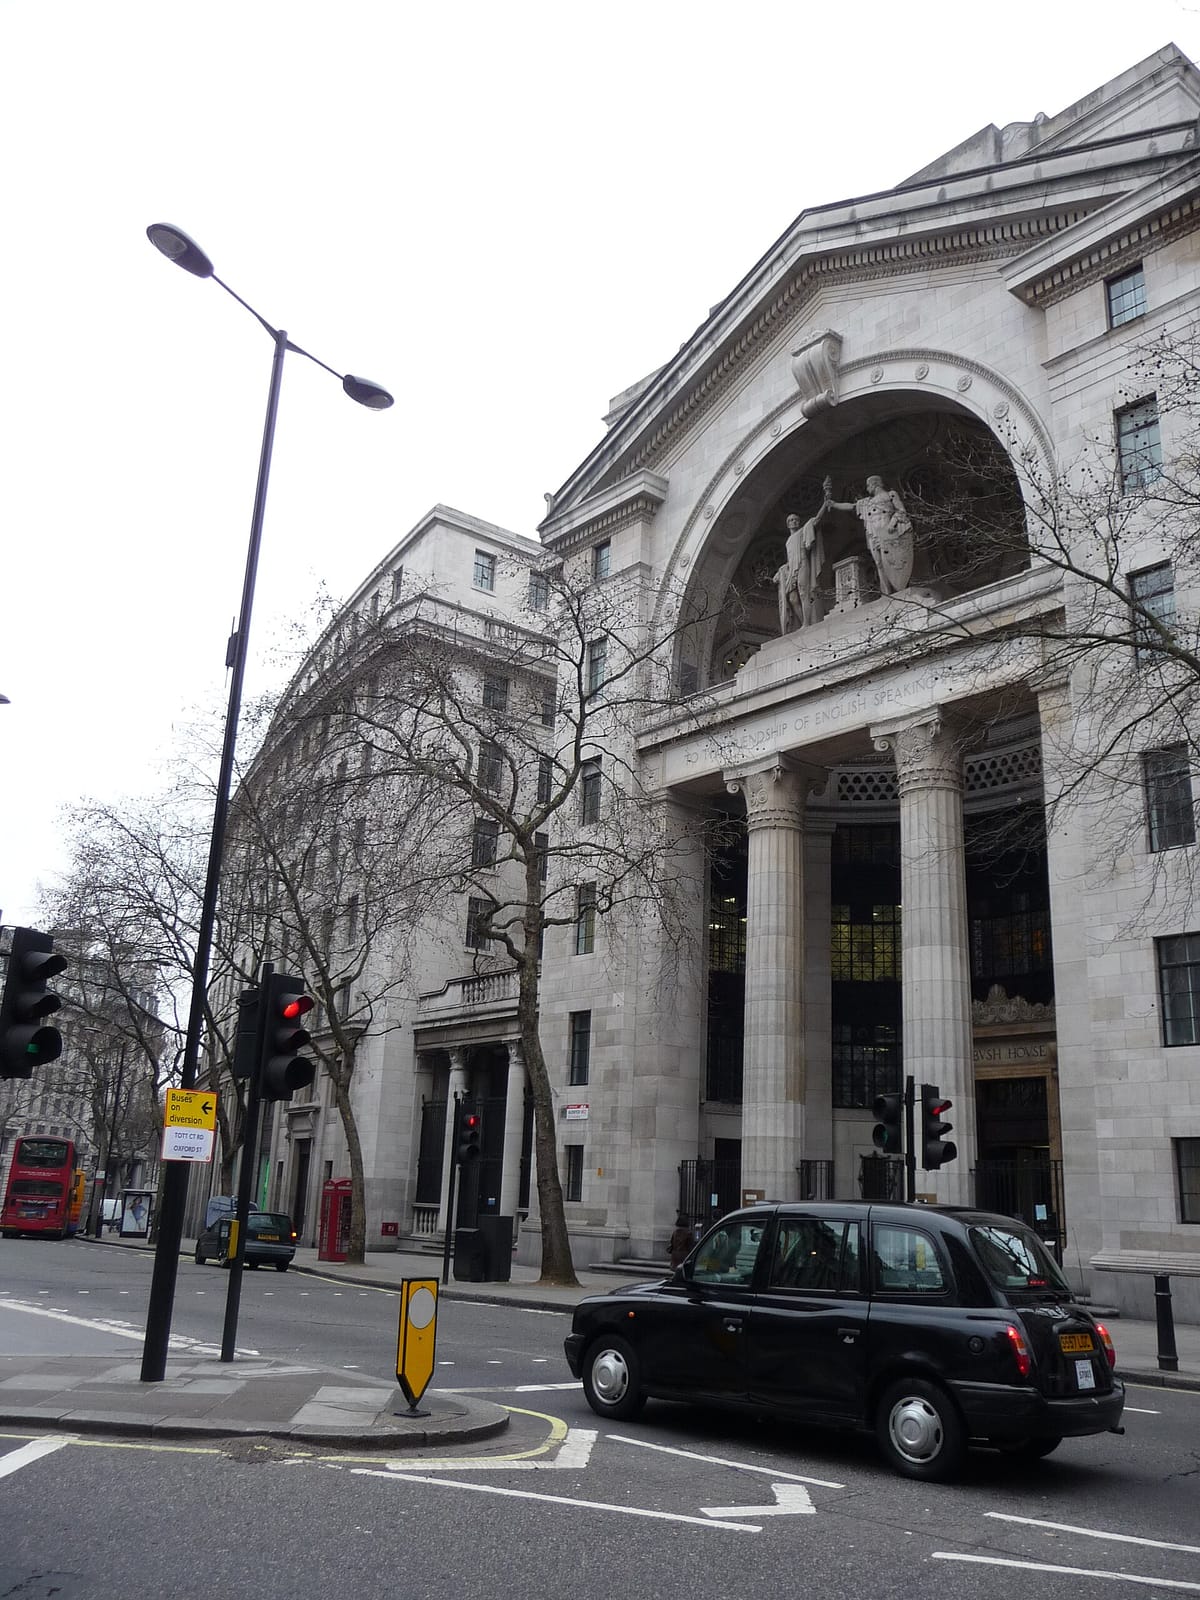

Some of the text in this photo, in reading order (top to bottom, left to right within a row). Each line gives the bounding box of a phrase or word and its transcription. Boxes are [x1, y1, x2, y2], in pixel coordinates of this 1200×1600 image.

[727, 723, 788, 753] IENDSHIP
[794, 716, 810, 731] OF
[815, 699, 866, 725] ENGLISH
[874, 678, 936, 707] SPEAKING
[171, 1093, 192, 1103] Buses
[170, 1114, 202, 1125] diversion
[173, 1145, 195, 1153] OXFORD
